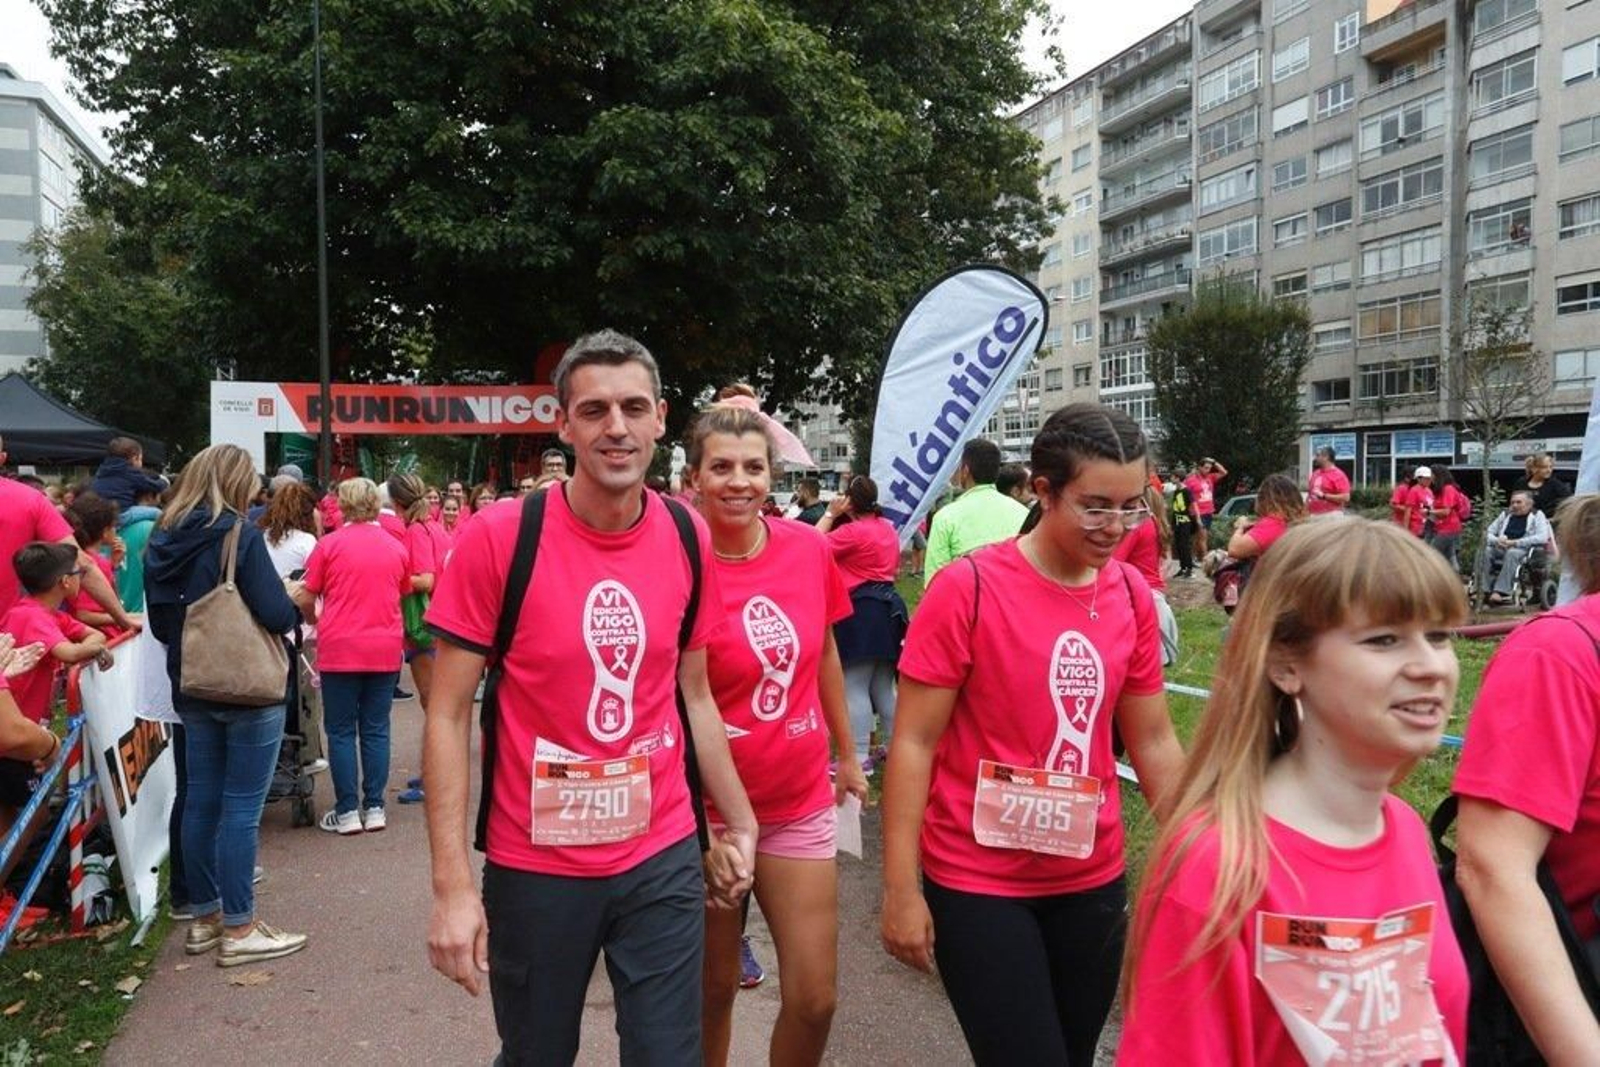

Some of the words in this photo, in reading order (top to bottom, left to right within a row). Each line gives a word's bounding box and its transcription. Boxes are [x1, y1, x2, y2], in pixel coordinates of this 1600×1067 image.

[600, 591, 620, 606] VI
[592, 615, 634, 628] VIGO
[751, 621, 785, 636] VIGO
[1065, 641, 1084, 657] VI
[1059, 666, 1096, 679] VIGO
[558, 786, 628, 820] 2790
[1000, 793, 1071, 831] 2785
